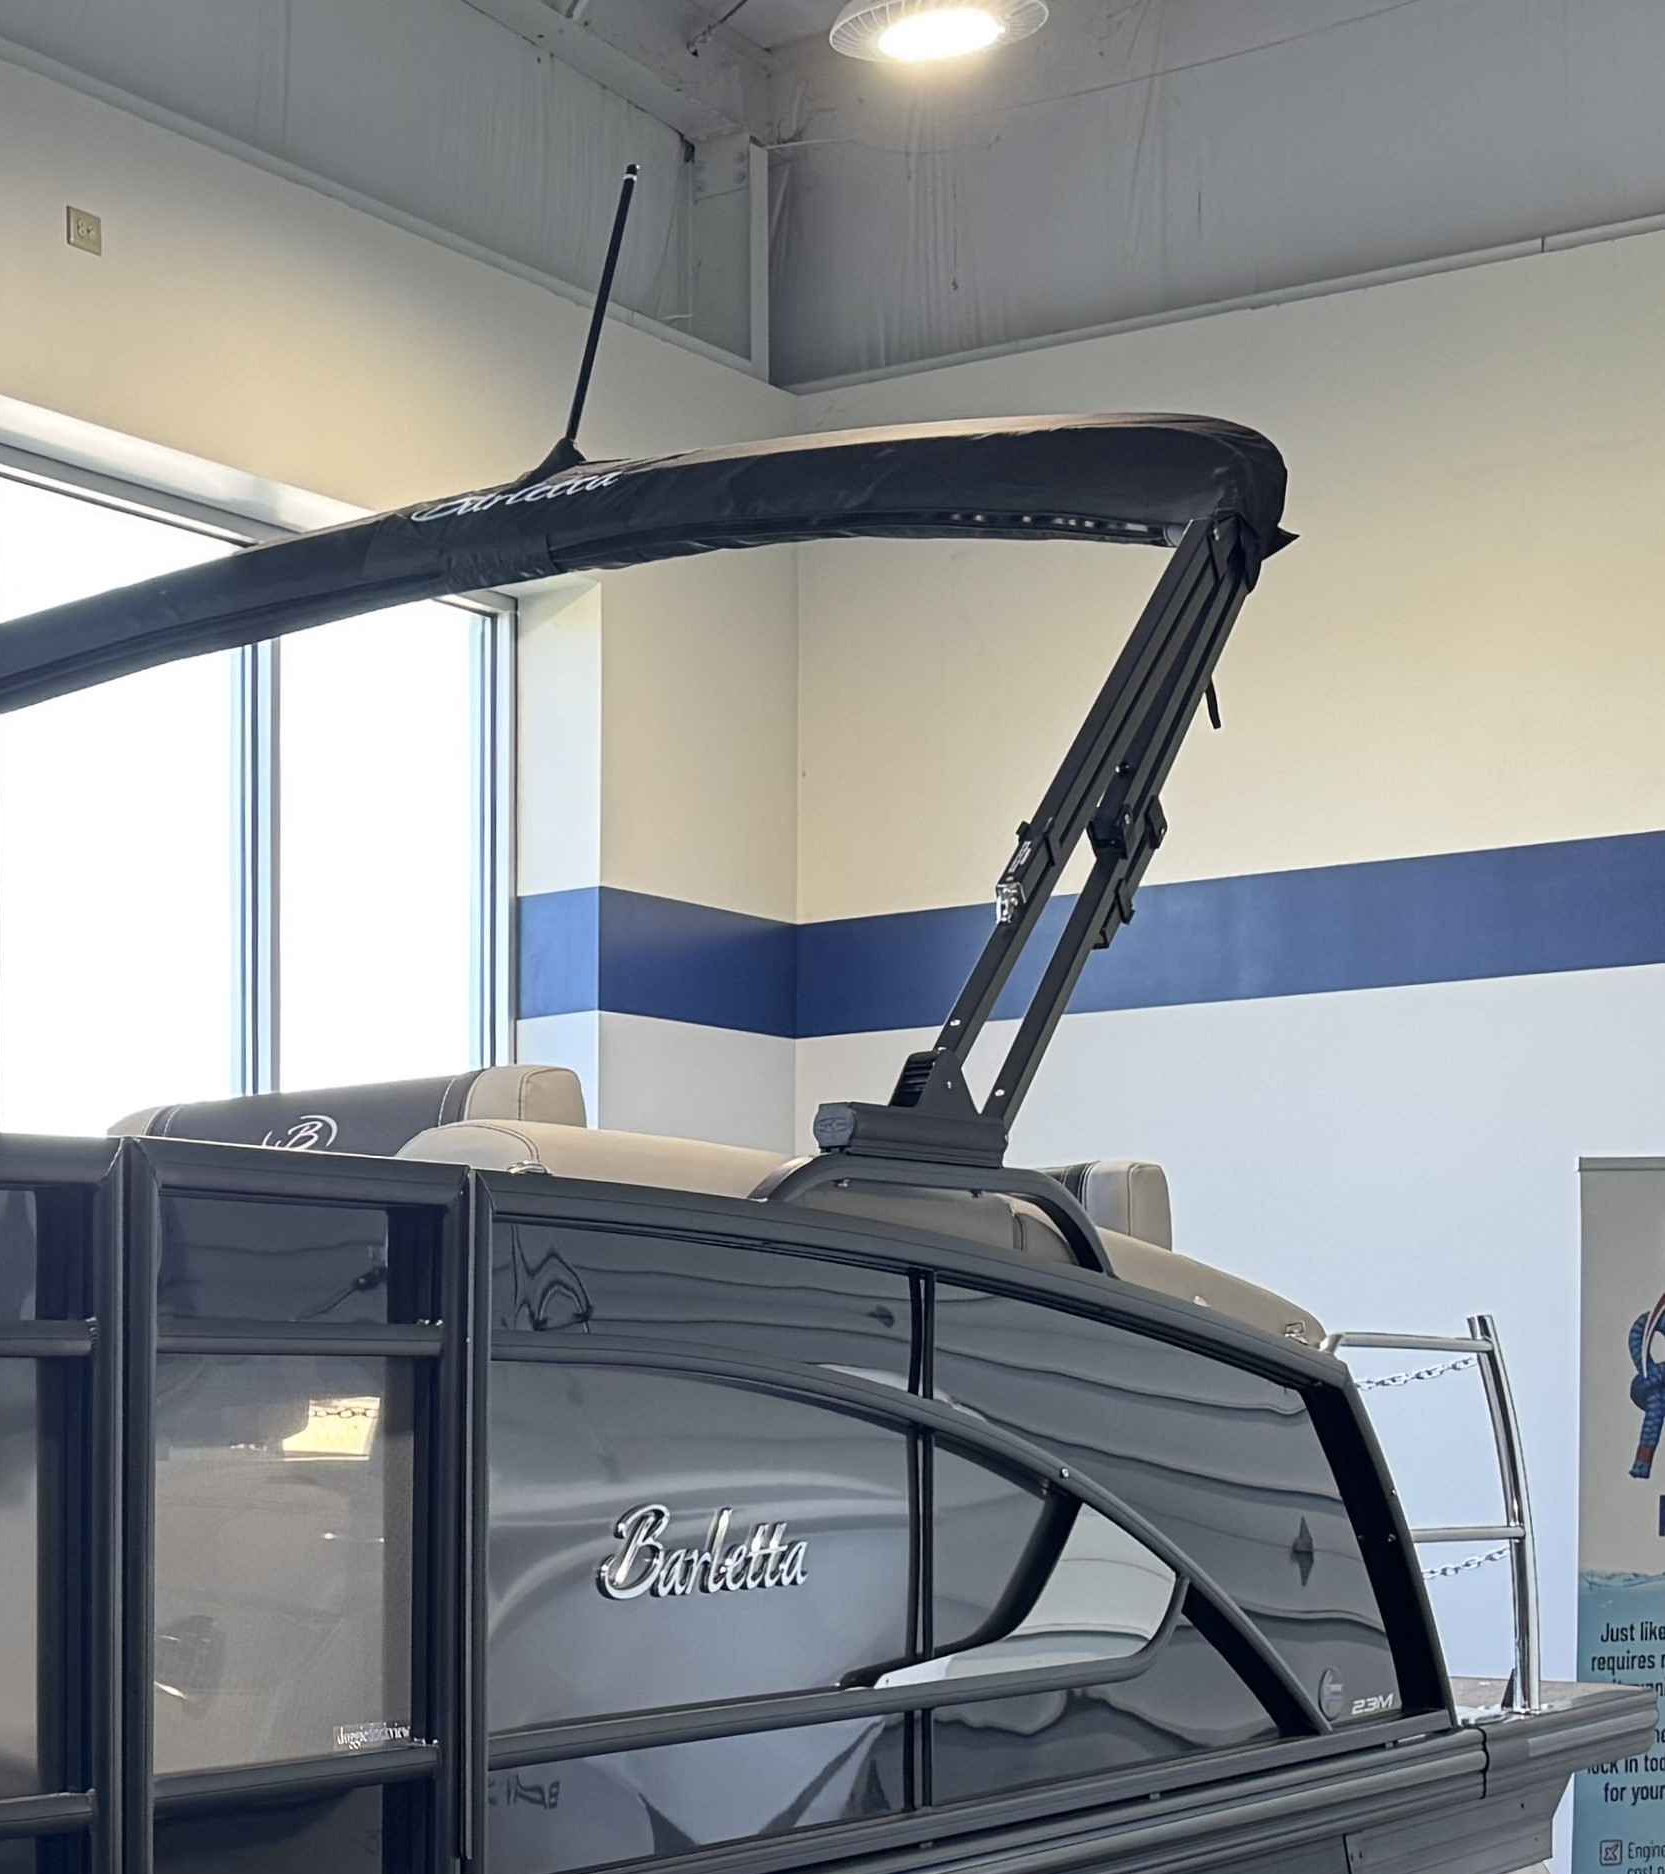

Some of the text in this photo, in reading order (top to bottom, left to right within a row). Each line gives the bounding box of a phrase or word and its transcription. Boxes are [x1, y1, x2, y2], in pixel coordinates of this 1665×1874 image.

[597, 1504, 809, 1600] Barletta
[1600, 1621, 1635, 1643] Just
[1591, 1648, 1656, 1676] requires
[1350, 1693, 1394, 1715] 23M
[1603, 1782, 1627, 1802] for
